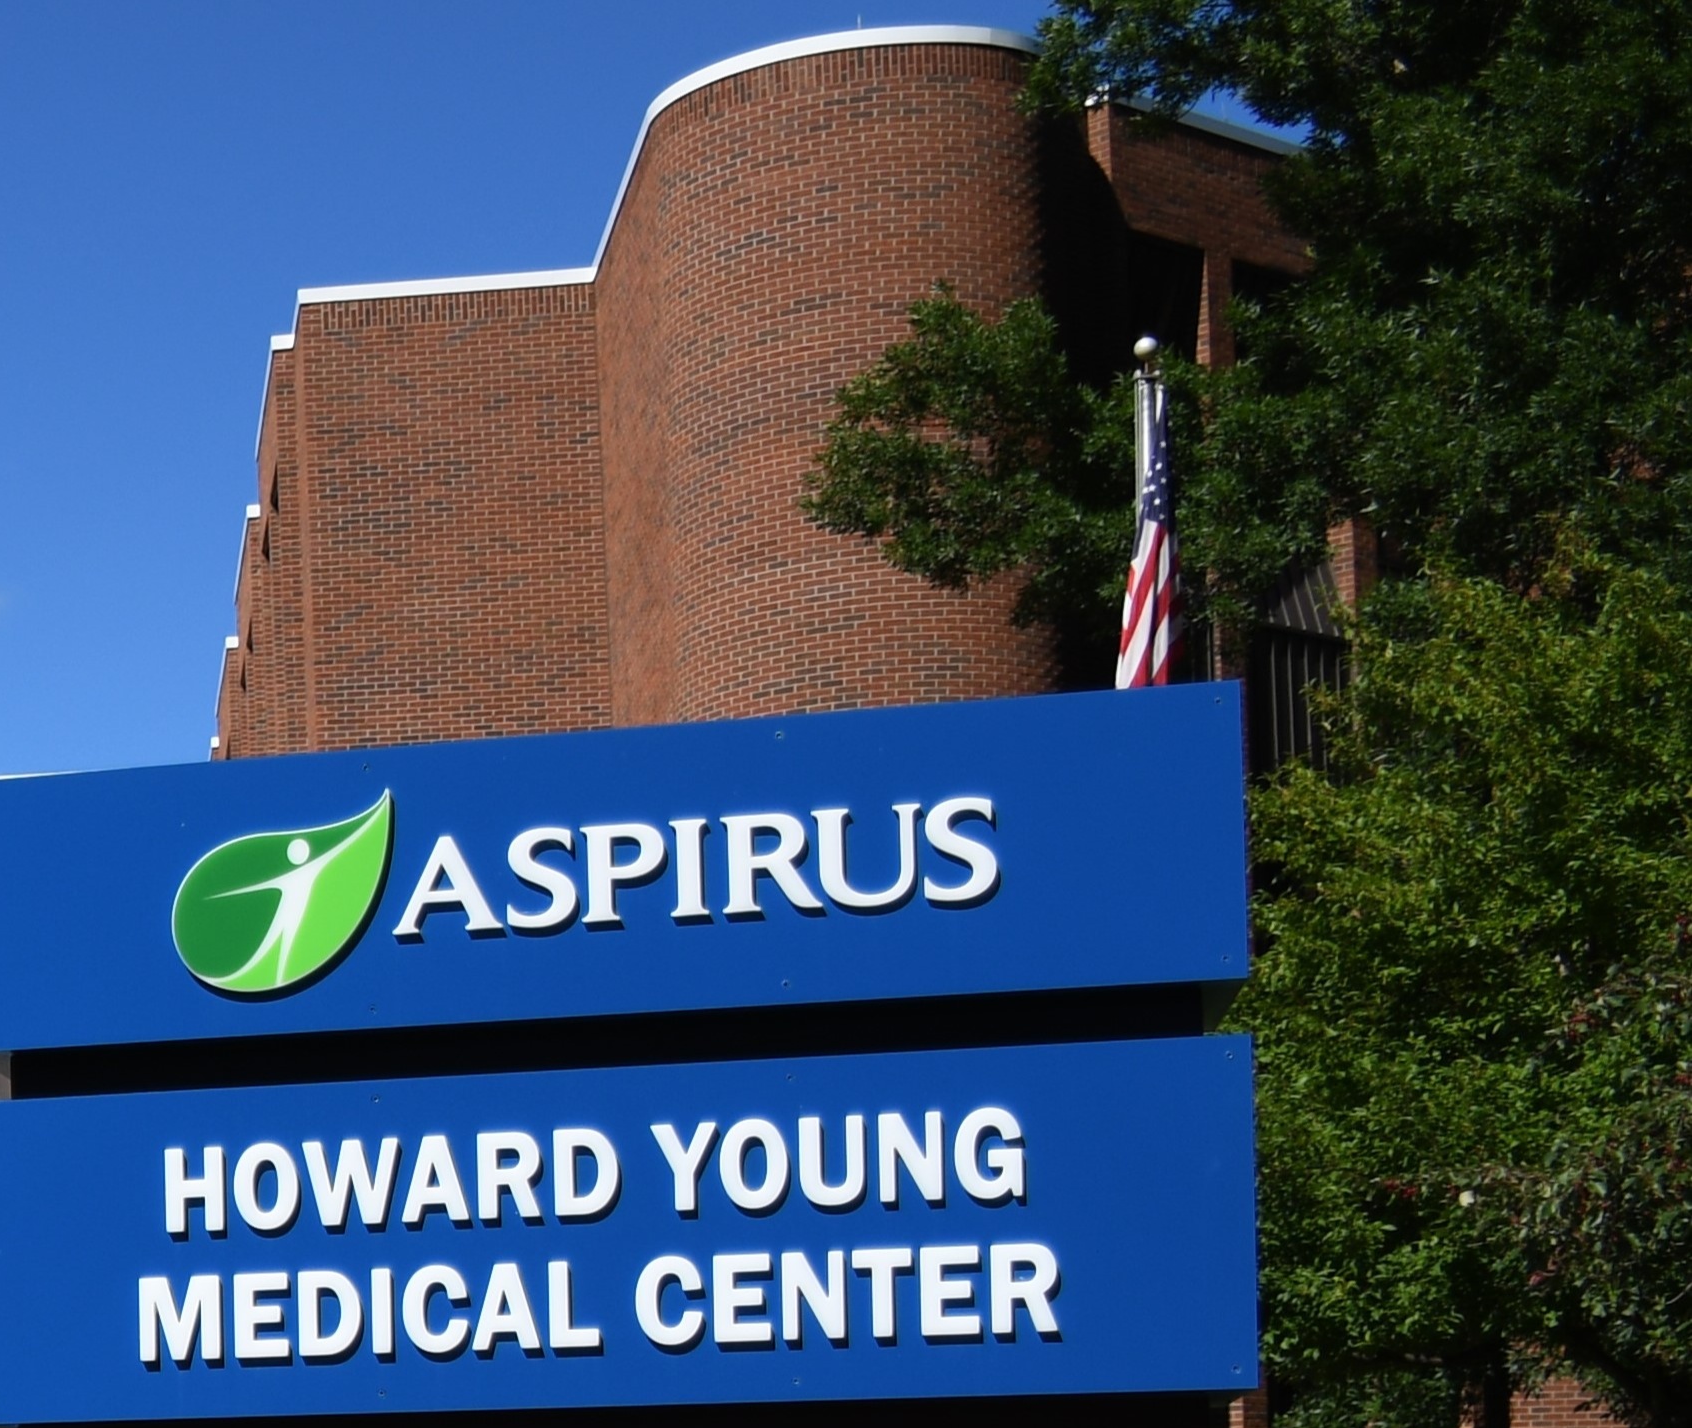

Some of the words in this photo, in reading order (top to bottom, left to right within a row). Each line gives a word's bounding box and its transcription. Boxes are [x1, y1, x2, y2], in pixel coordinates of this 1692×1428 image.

[393, 796, 997, 934] ASPIRUS
[165, 1128, 618, 1232] HOWARD
[651, 1106, 1023, 1210] YOUNG
[139, 1260, 600, 1361] MEDICAL
[636, 1242, 1058, 1344] CENTER
